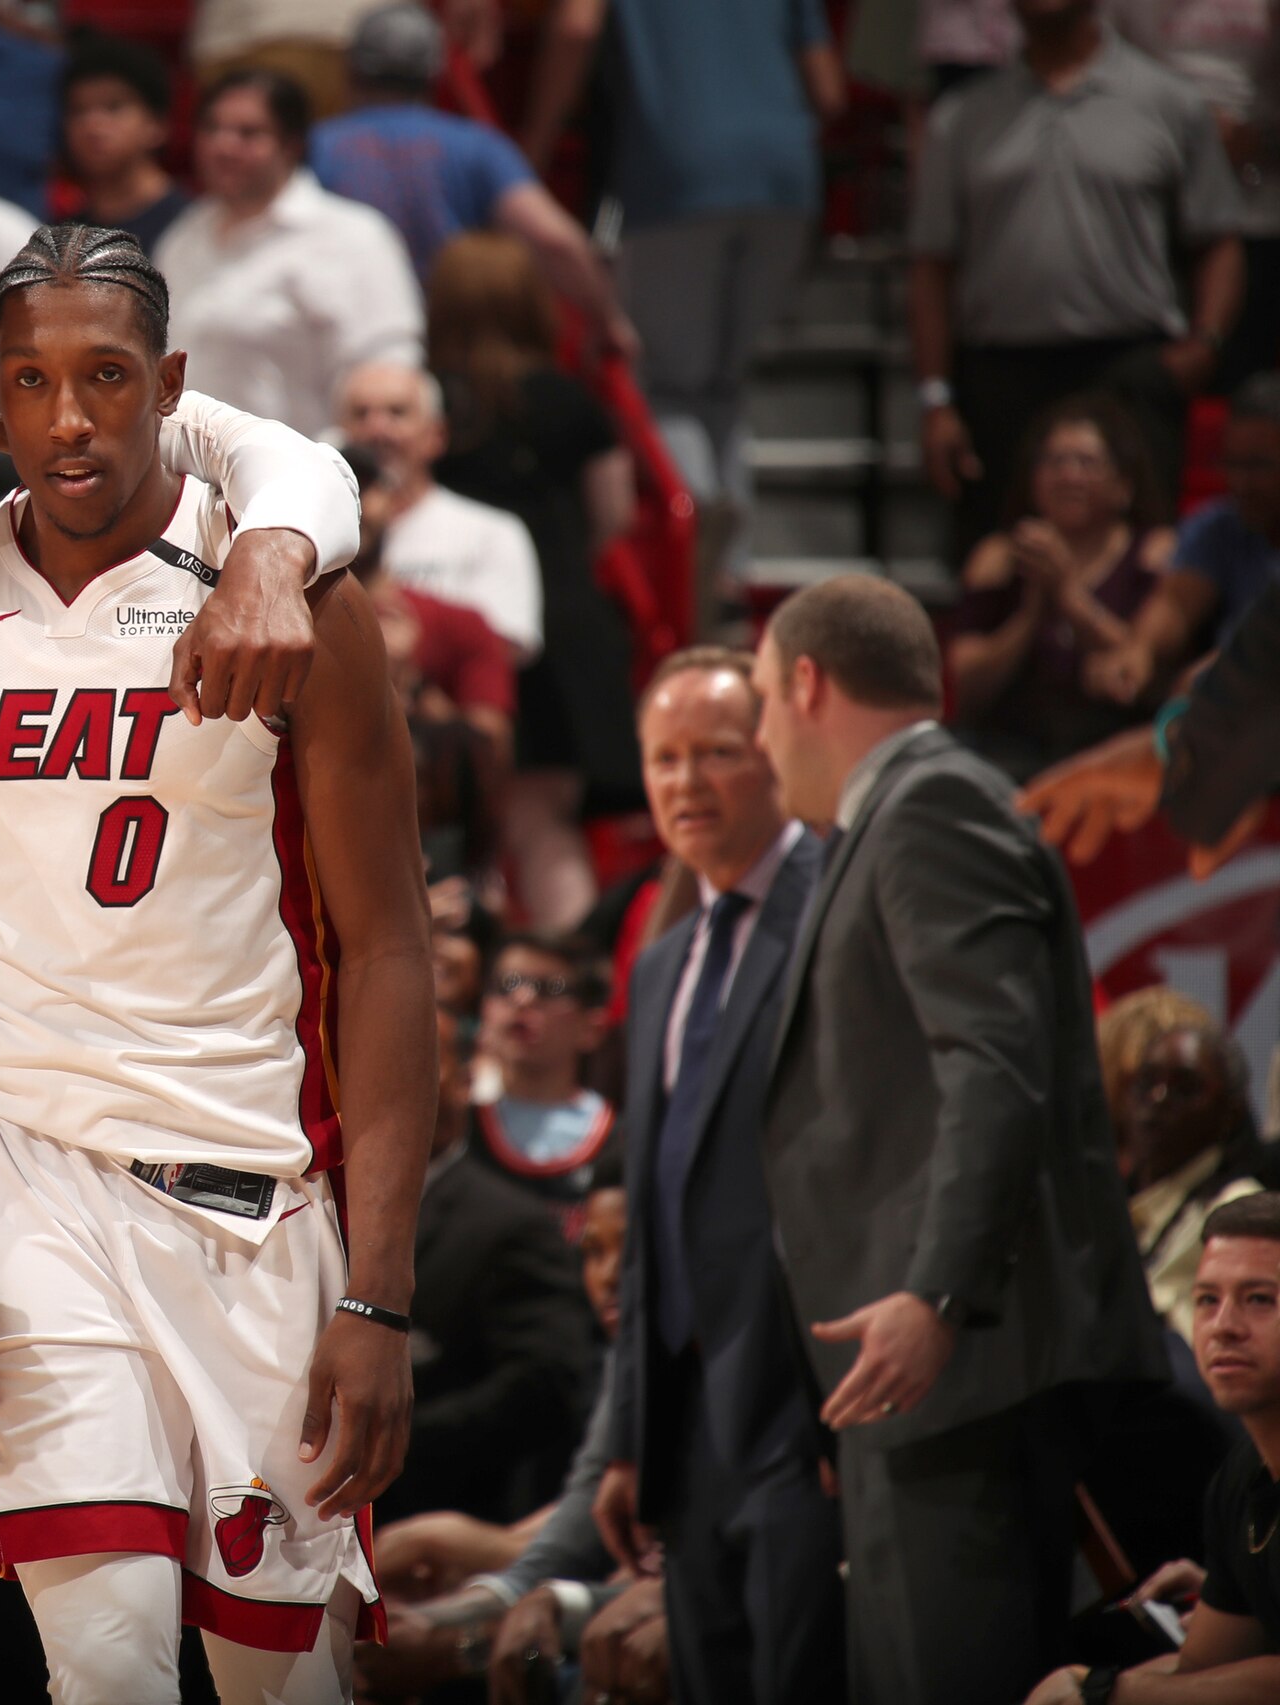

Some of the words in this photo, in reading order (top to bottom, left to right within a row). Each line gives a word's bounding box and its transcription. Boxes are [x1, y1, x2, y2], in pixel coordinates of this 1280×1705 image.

[177, 552, 213, 581] MSD
[116, 607, 195, 625] Ultimate
[120, 626, 184, 636] SOFTWAR
[85, 795, 169, 907] 0
